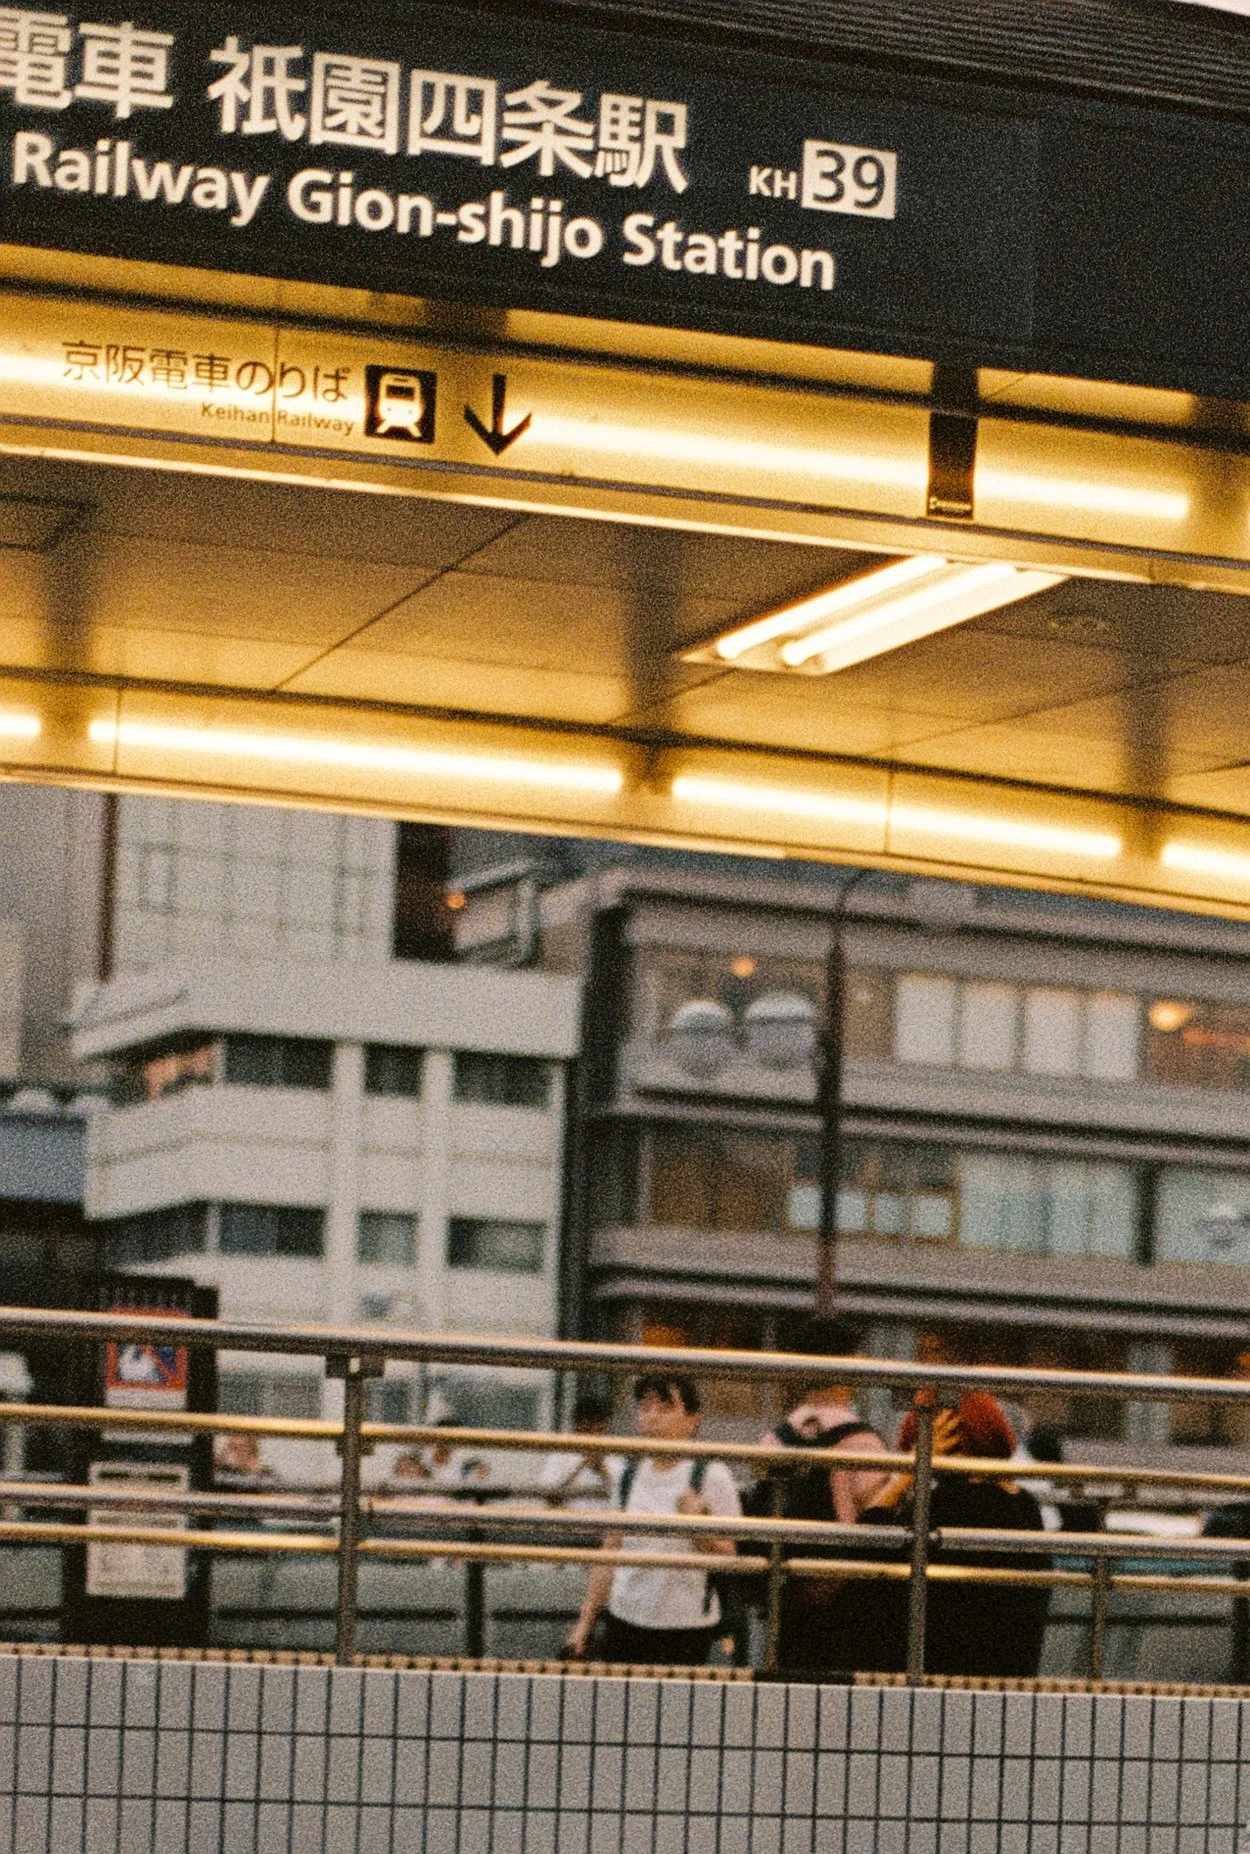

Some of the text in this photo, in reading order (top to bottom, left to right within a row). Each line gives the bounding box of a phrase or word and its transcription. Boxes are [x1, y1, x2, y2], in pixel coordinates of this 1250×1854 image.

[207, 36, 689, 194] 祇園四条駅
[13, 131, 836, 291] Railway Gion-shijo Station
[749, 149, 886, 210] KH 39
[61, 340, 352, 403] 京阪電車のりば
[201, 402, 355, 437] Keihan Railway
